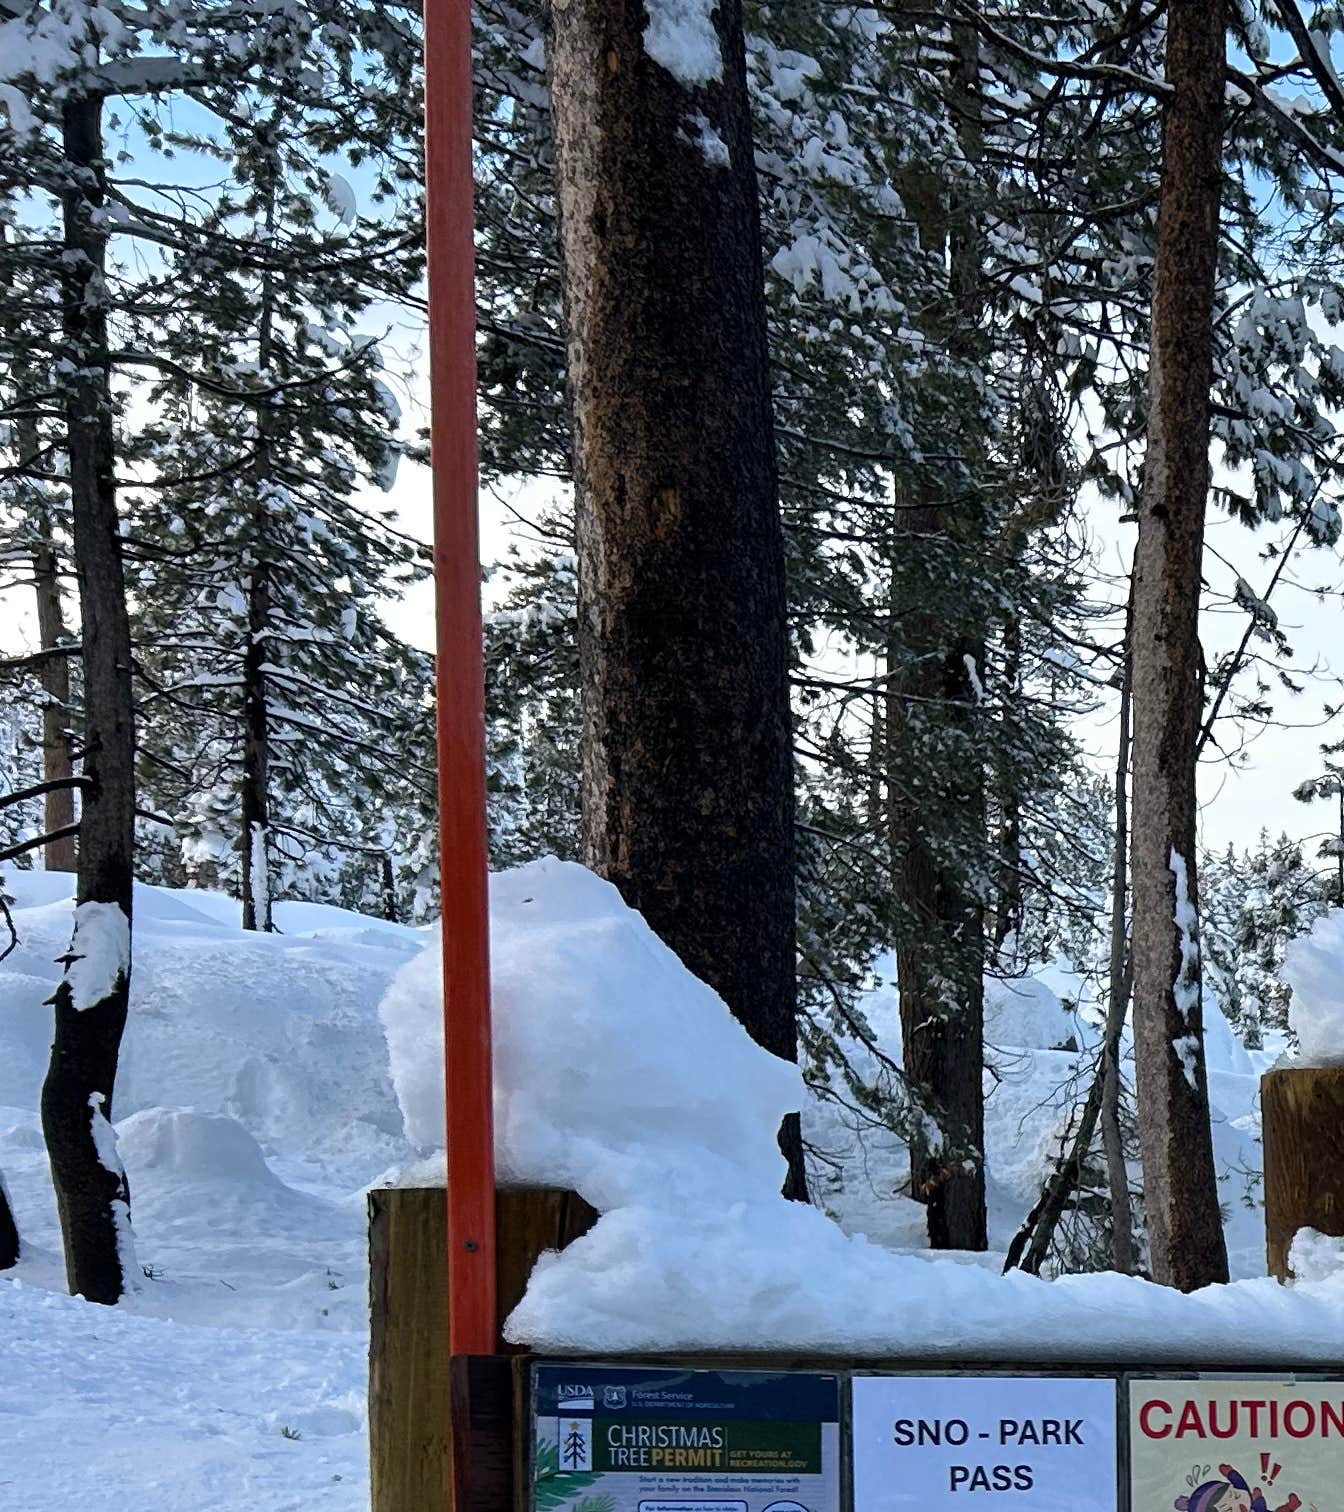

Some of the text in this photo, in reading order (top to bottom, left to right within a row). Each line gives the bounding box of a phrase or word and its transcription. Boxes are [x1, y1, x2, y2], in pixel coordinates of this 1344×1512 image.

[558, 1385, 594, 1396] USDA
[632, 1390, 693, 1400] Forest Service
[608, 1425, 723, 1447] CHRISTMAS
[894, 1419, 969, 1447] SNO
[1000, 1419, 1084, 1447] PARK
[608, 1448, 721, 1466] TREE PERMIT
[950, 1465, 1034, 1492] PASS
